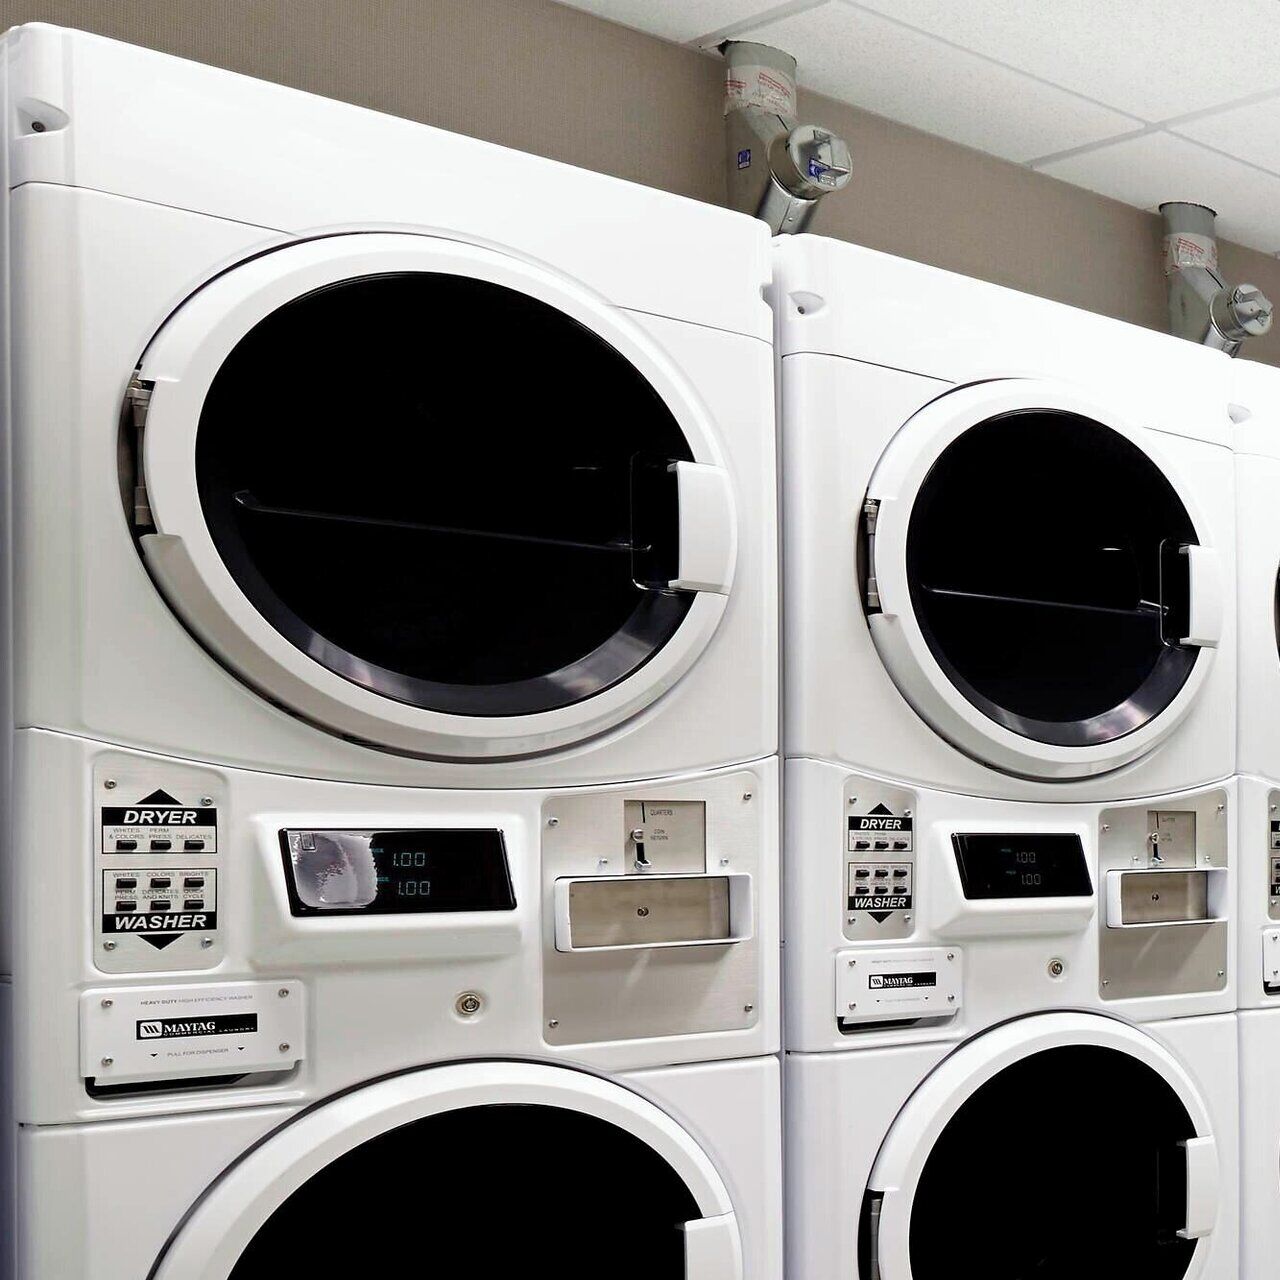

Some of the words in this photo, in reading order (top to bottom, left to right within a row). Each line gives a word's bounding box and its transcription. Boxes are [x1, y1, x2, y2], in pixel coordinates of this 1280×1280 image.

[123, 810, 198, 824] DRYER
[860, 818, 902, 830] DRYER
[393, 852, 426, 867] 1.00
[398, 881, 430, 896] 1.00
[855, 897, 907, 908] WASHER
[115, 914, 207, 930] WASHER
[883, 976, 913, 985] MAYTAG
[163, 1021, 216, 1034] MAYTAG
